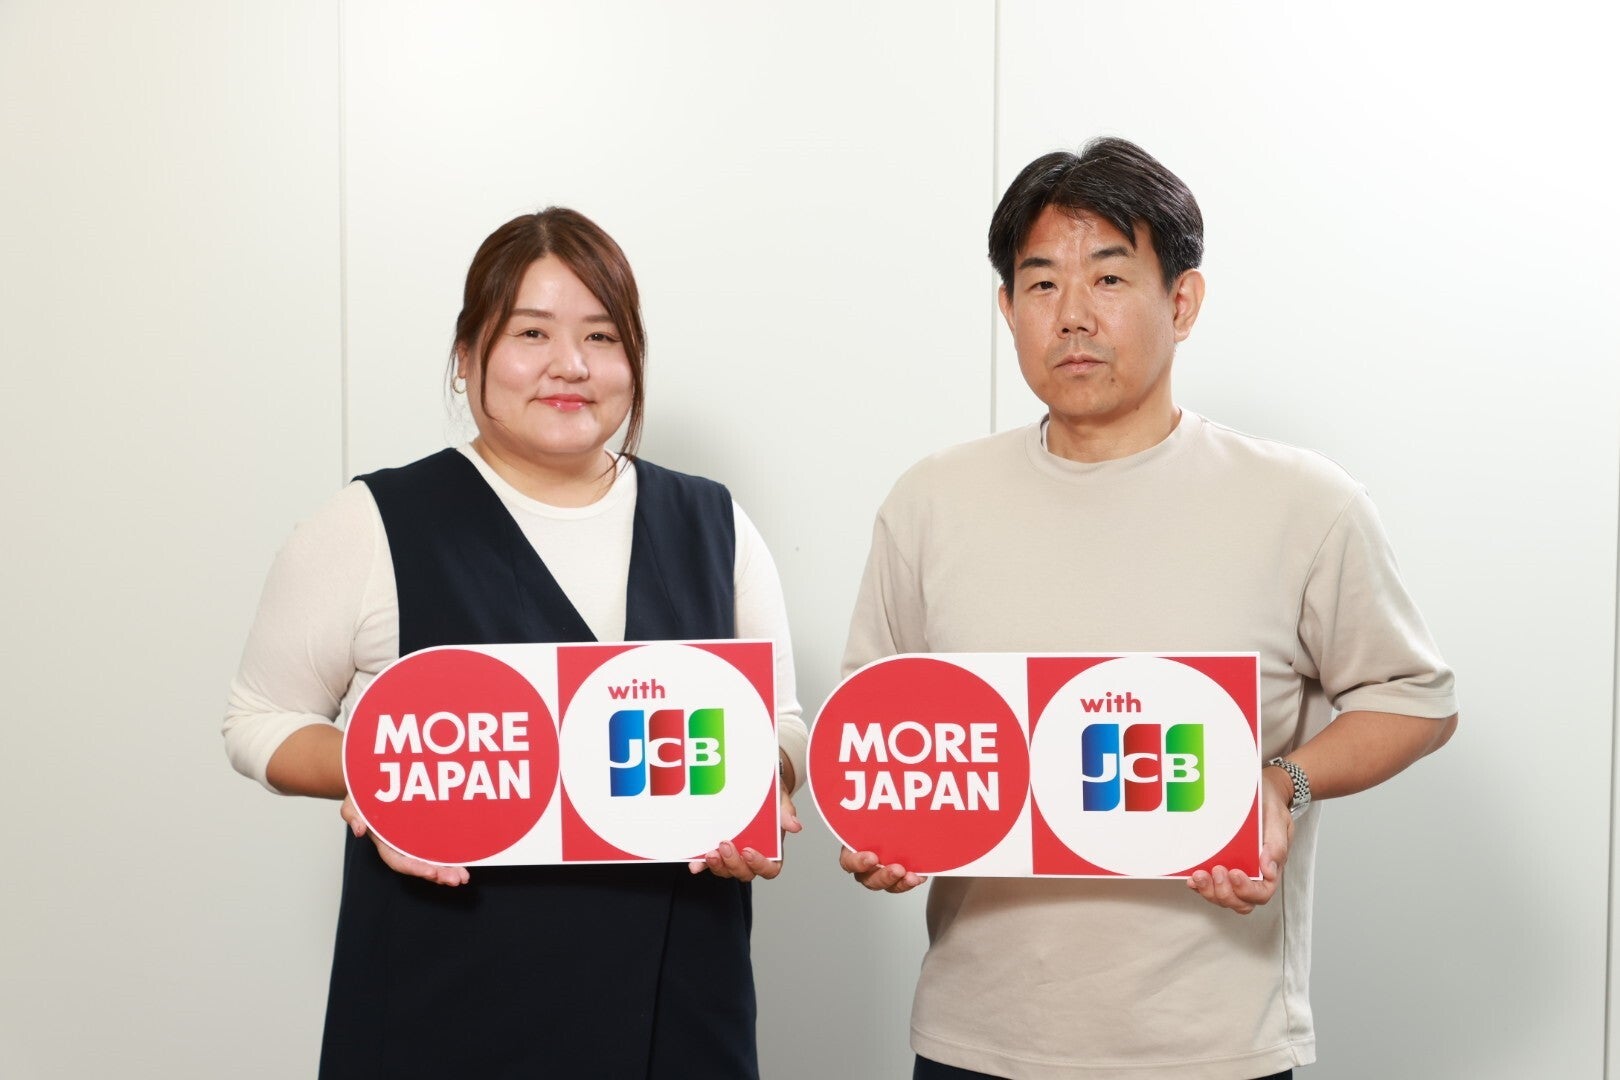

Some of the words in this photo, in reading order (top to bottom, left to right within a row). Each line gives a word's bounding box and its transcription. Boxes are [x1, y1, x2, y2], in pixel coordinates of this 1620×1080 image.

[608, 678, 666, 699] with
[1080, 691, 1142, 713] with
[374, 711, 529, 754] MORE
[839, 721, 998, 764] MORE
[609, 737, 722, 769] JCB
[1082, 752, 1201, 784] JCB
[375, 760, 531, 803] JAPAN
[840, 771, 1000, 811] JAPAN
